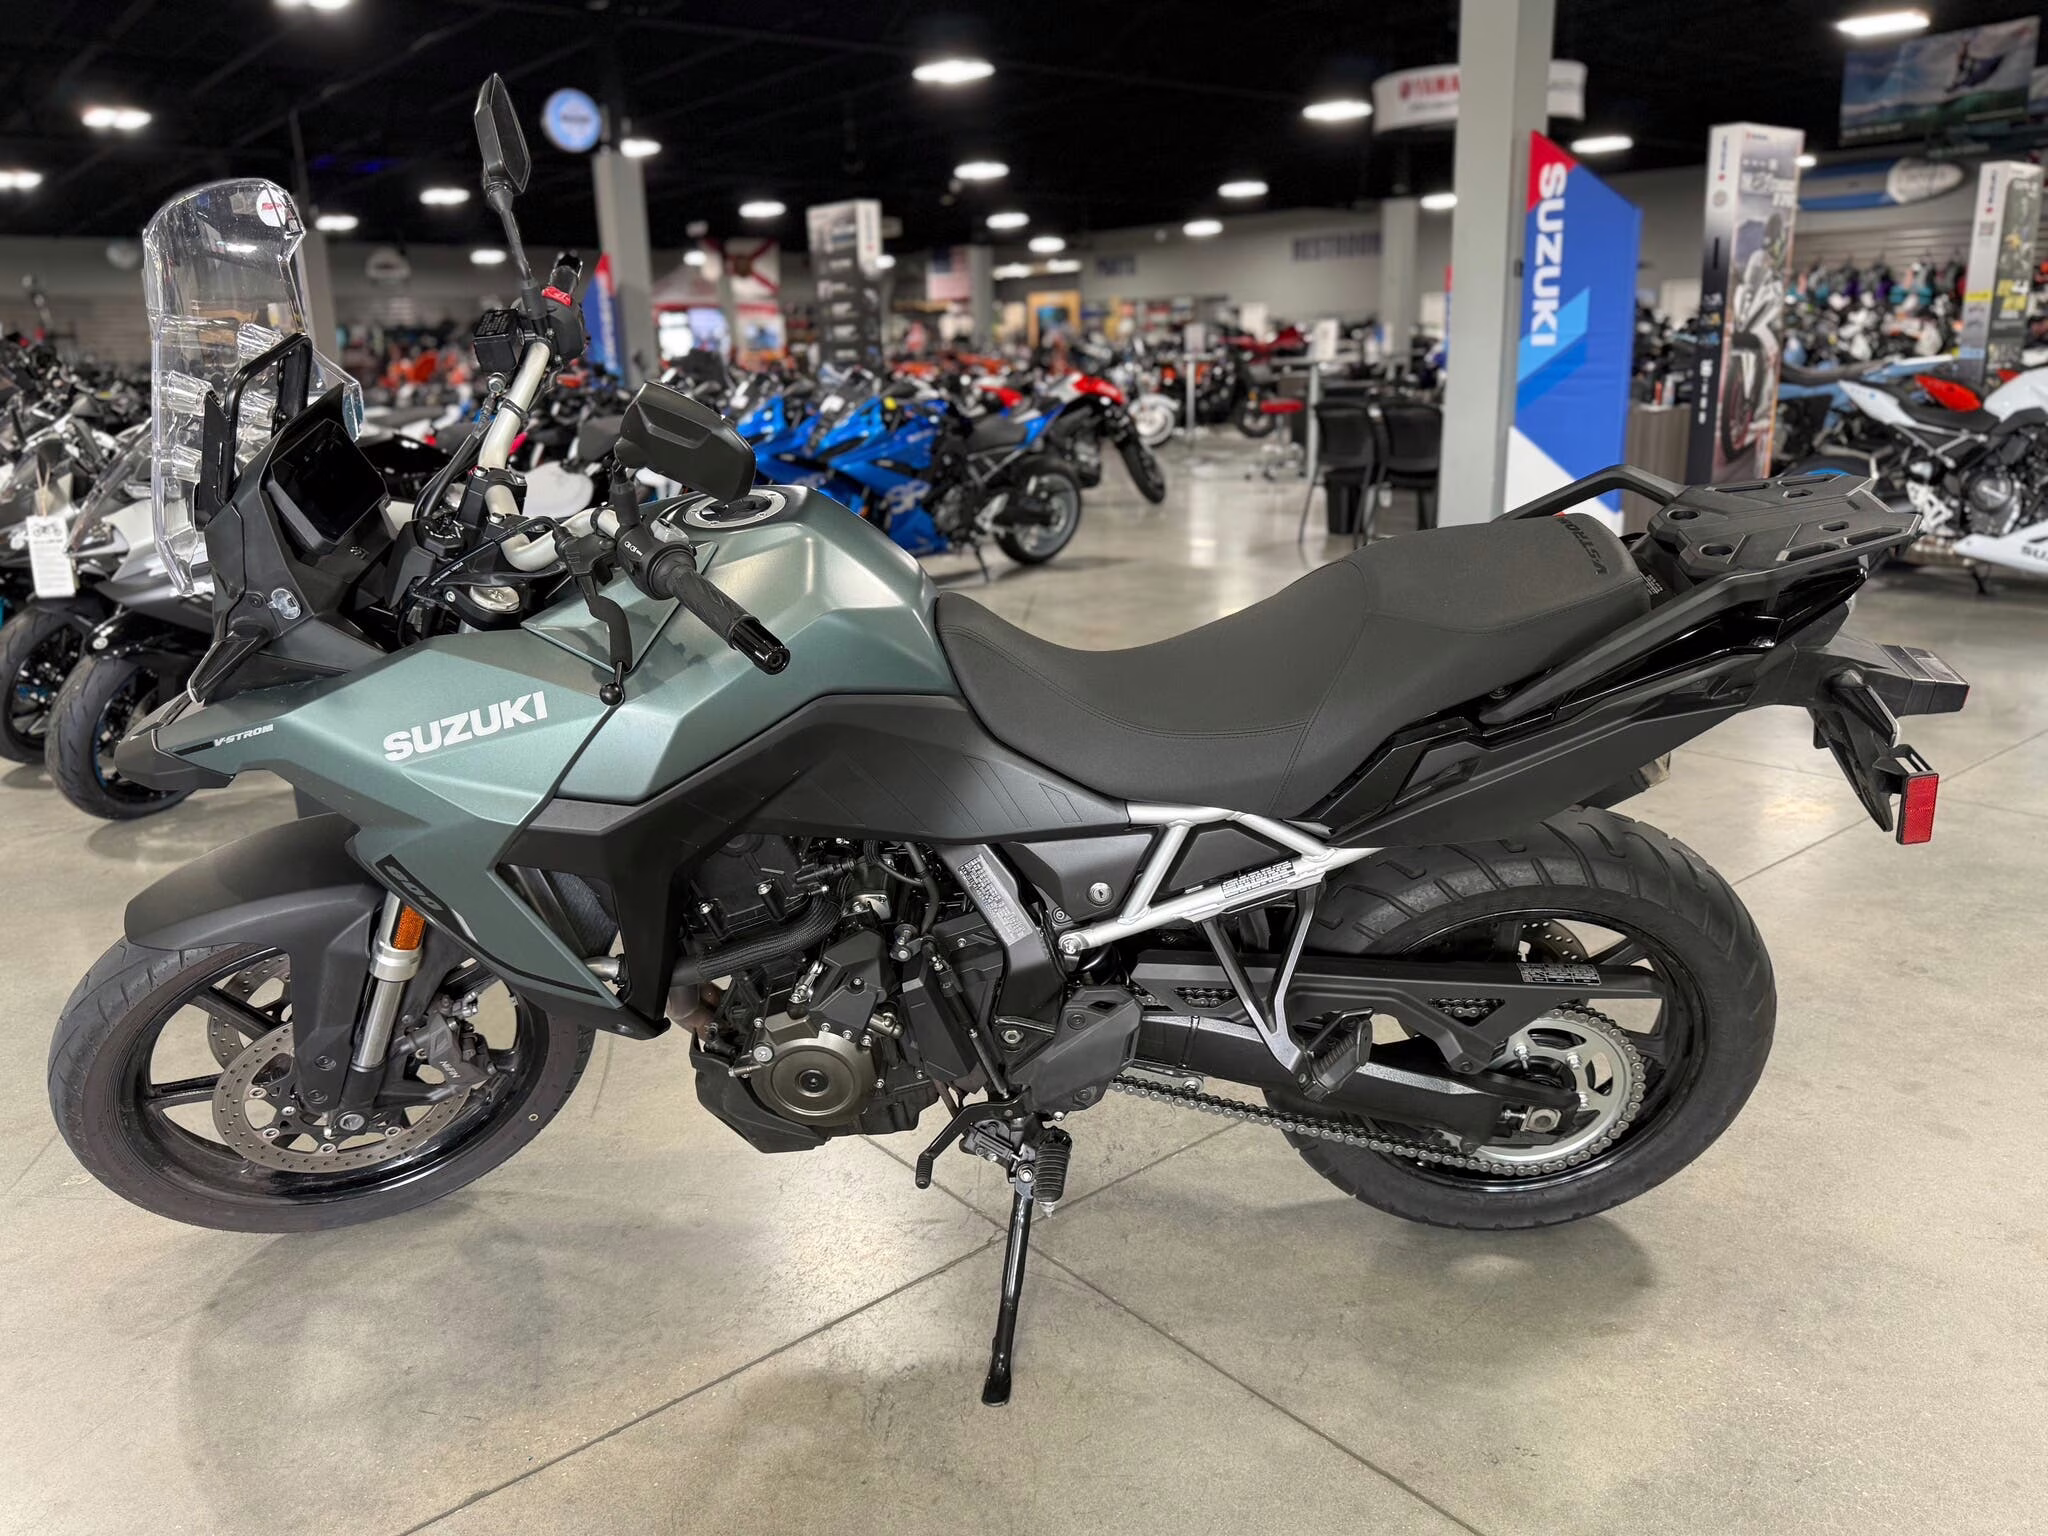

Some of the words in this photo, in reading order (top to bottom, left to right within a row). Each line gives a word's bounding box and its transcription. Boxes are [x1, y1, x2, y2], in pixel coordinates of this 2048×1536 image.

[1530, 161, 1567, 347] SUZUKI
[213, 723, 274, 747] V-STROM
[383, 690, 548, 762] SUZUKI
